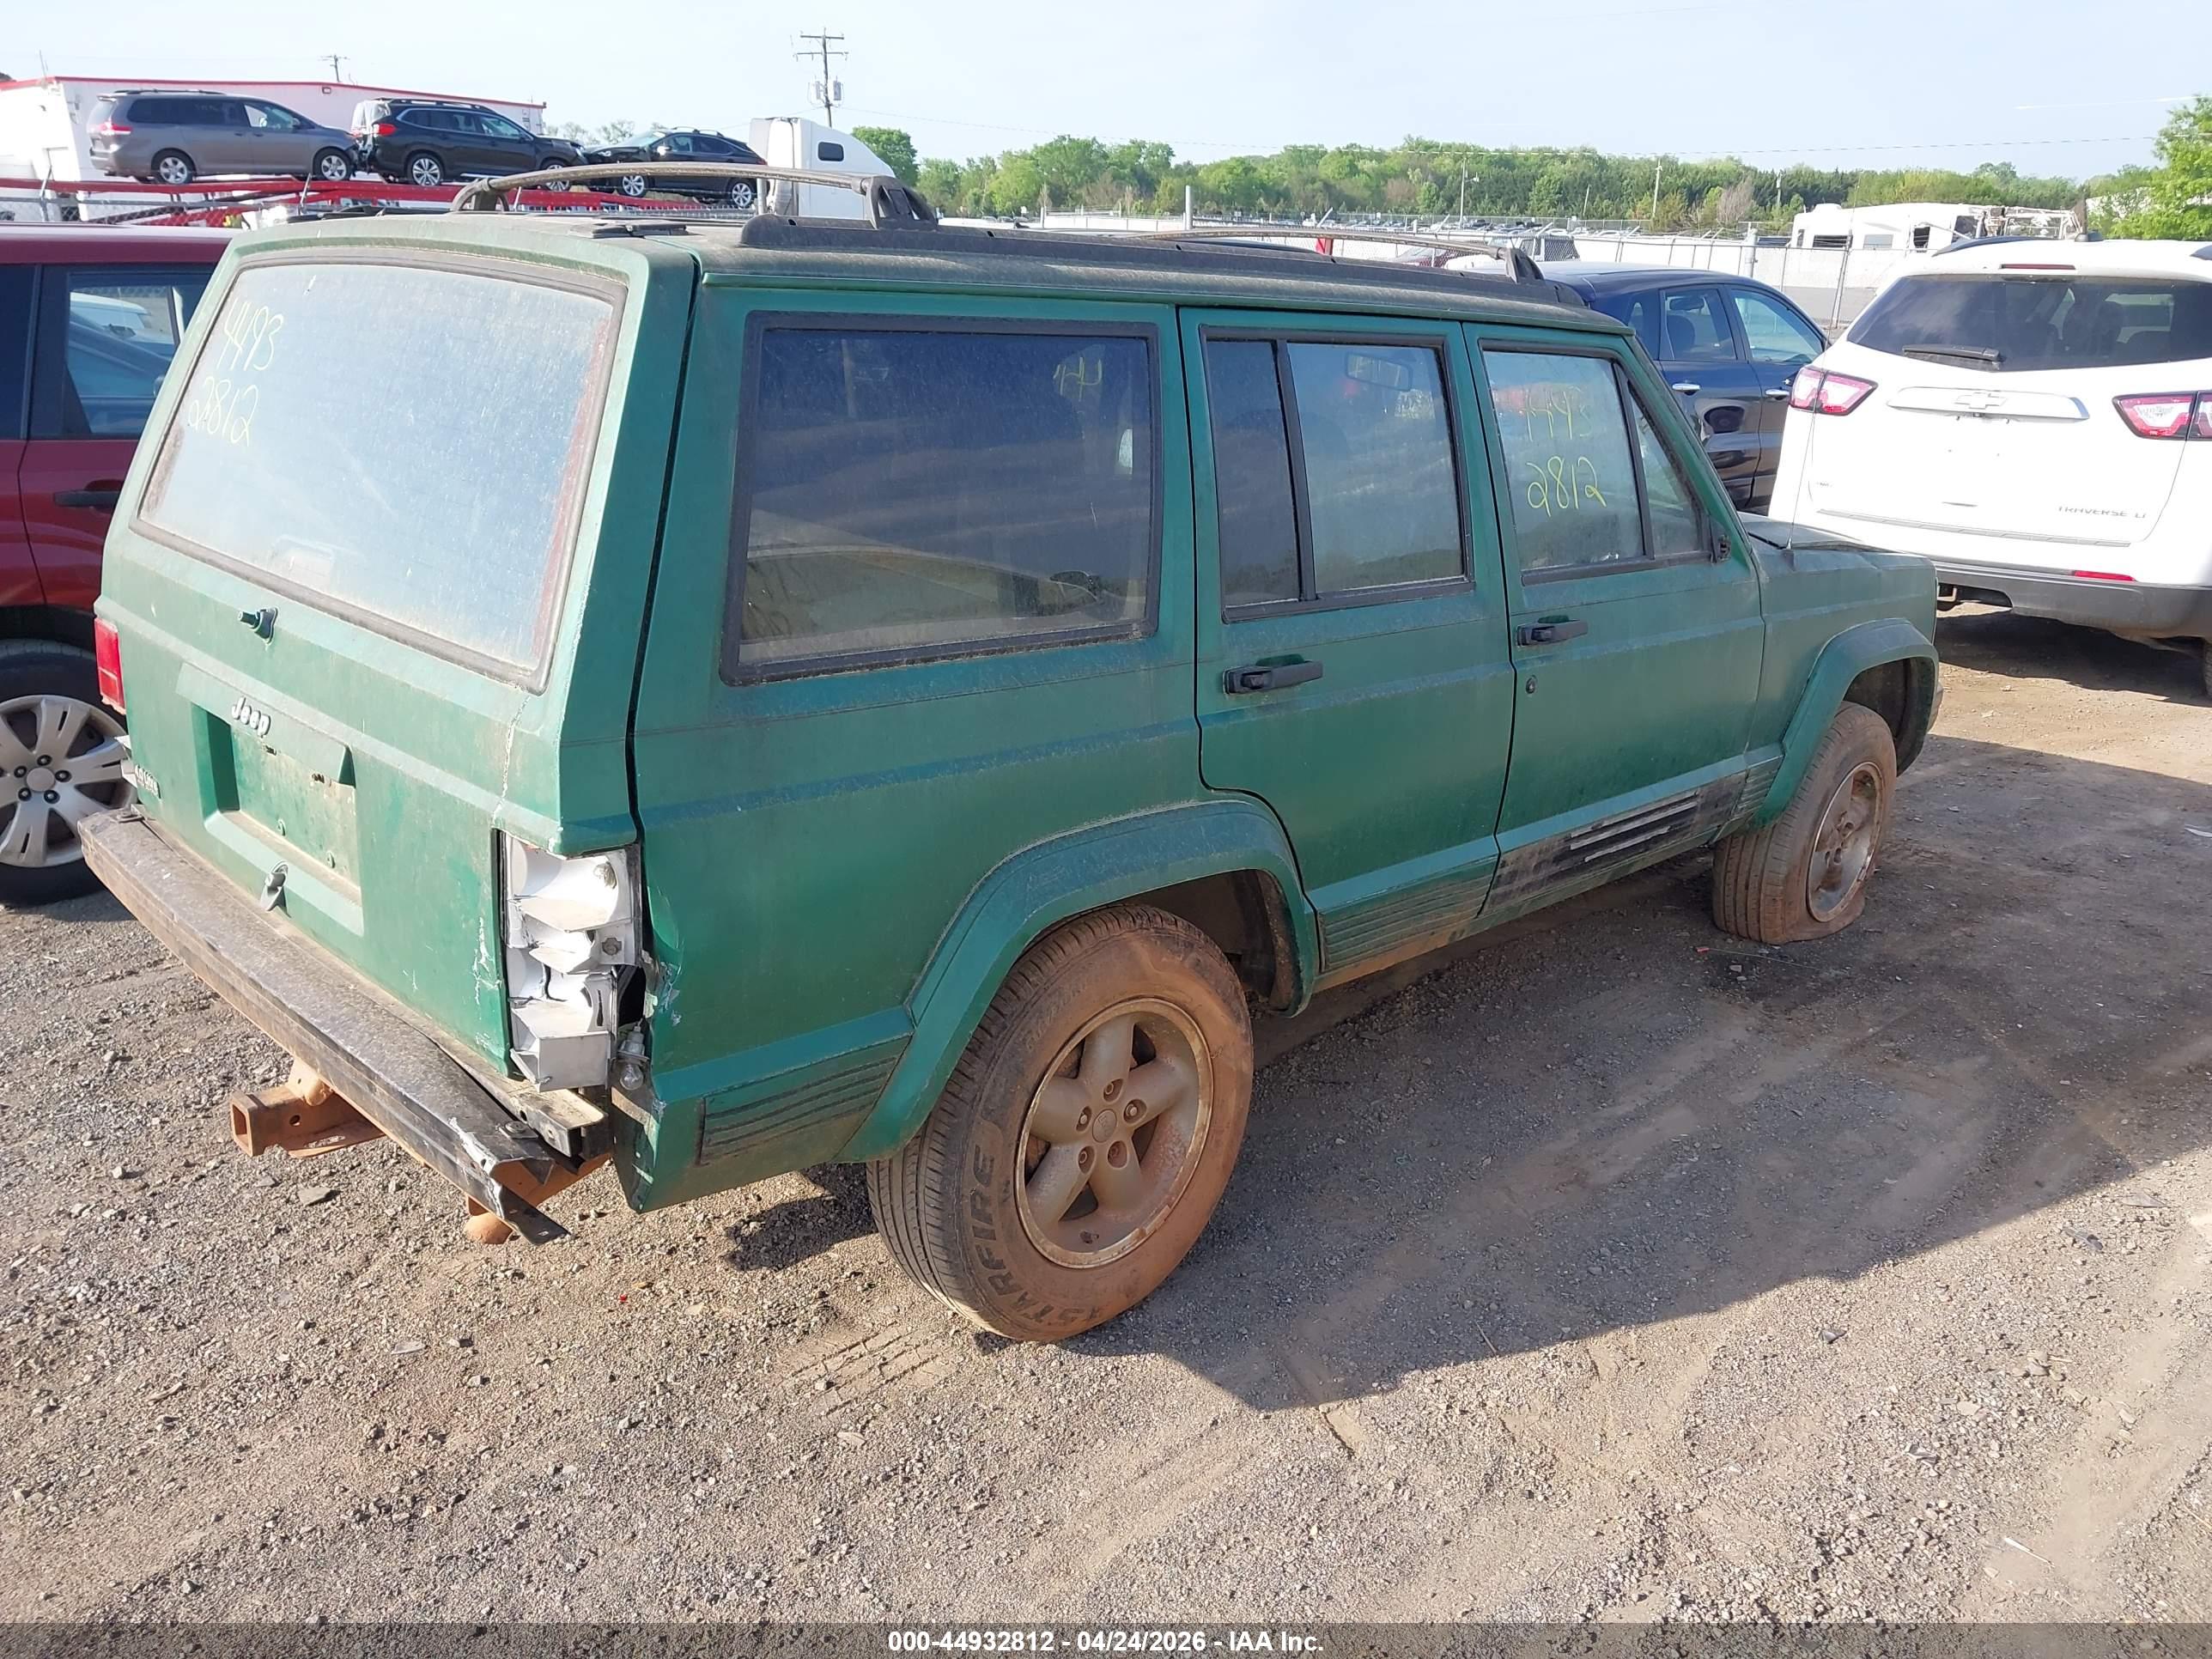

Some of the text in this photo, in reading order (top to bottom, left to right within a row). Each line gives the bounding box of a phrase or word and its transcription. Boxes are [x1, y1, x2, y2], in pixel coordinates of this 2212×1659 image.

[216, 296, 285, 372] 4493
[186, 375, 259, 447] 2812
[1526, 455, 1608, 518] 2812
[230, 696, 272, 739] Jeep
[969, 1144, 1087, 1327] STARFIRE
